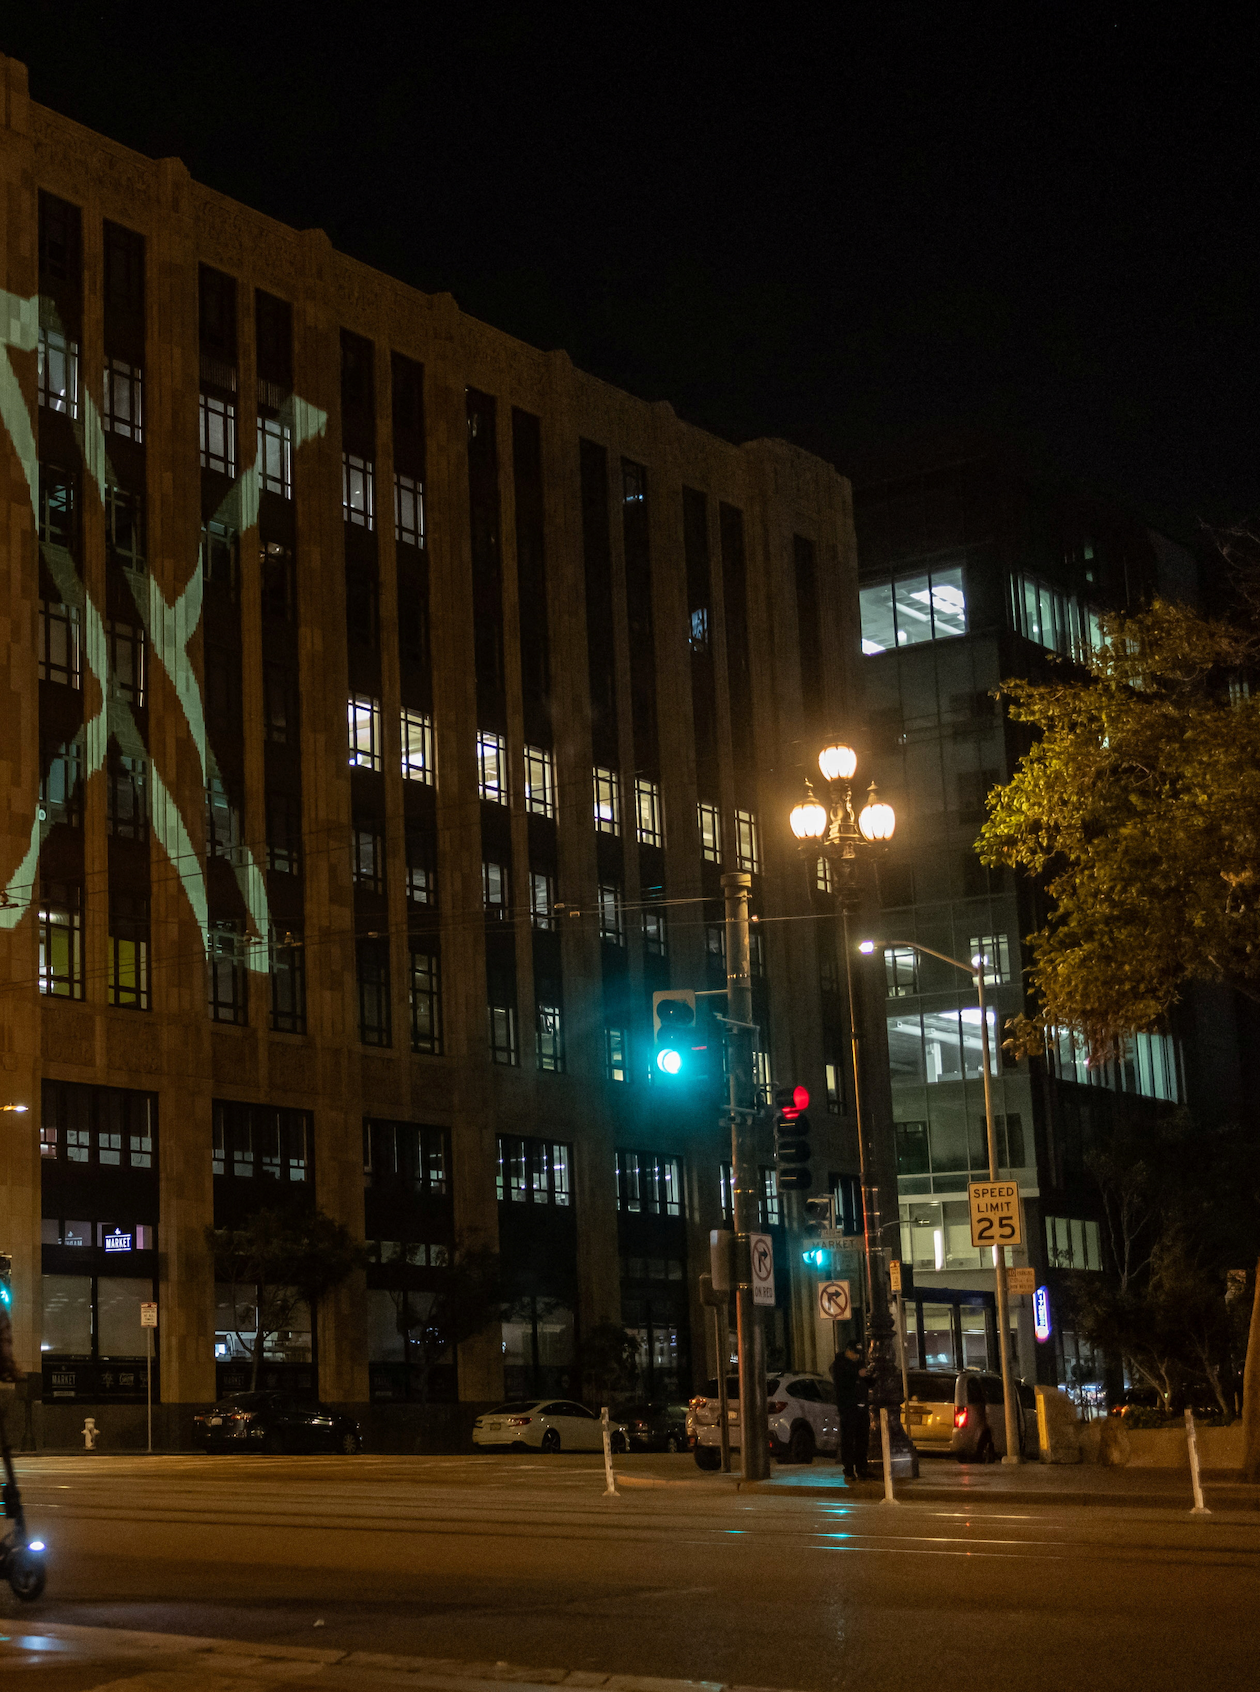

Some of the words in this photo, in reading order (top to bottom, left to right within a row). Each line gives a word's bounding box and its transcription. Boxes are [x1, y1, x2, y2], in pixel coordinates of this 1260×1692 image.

[973, 1187, 1014, 1198] SPEED
[977, 1201, 1011, 1213] LIMIT
[976, 1216, 1016, 1241] 25
[105, 1237, 131, 1249] MARKET
[812, 1240, 855, 1249] MARKET
[755, 1286, 762, 1297] ON
[763, 1287, 773, 1298] RED
[51, 1374, 76, 1385] MARKET
